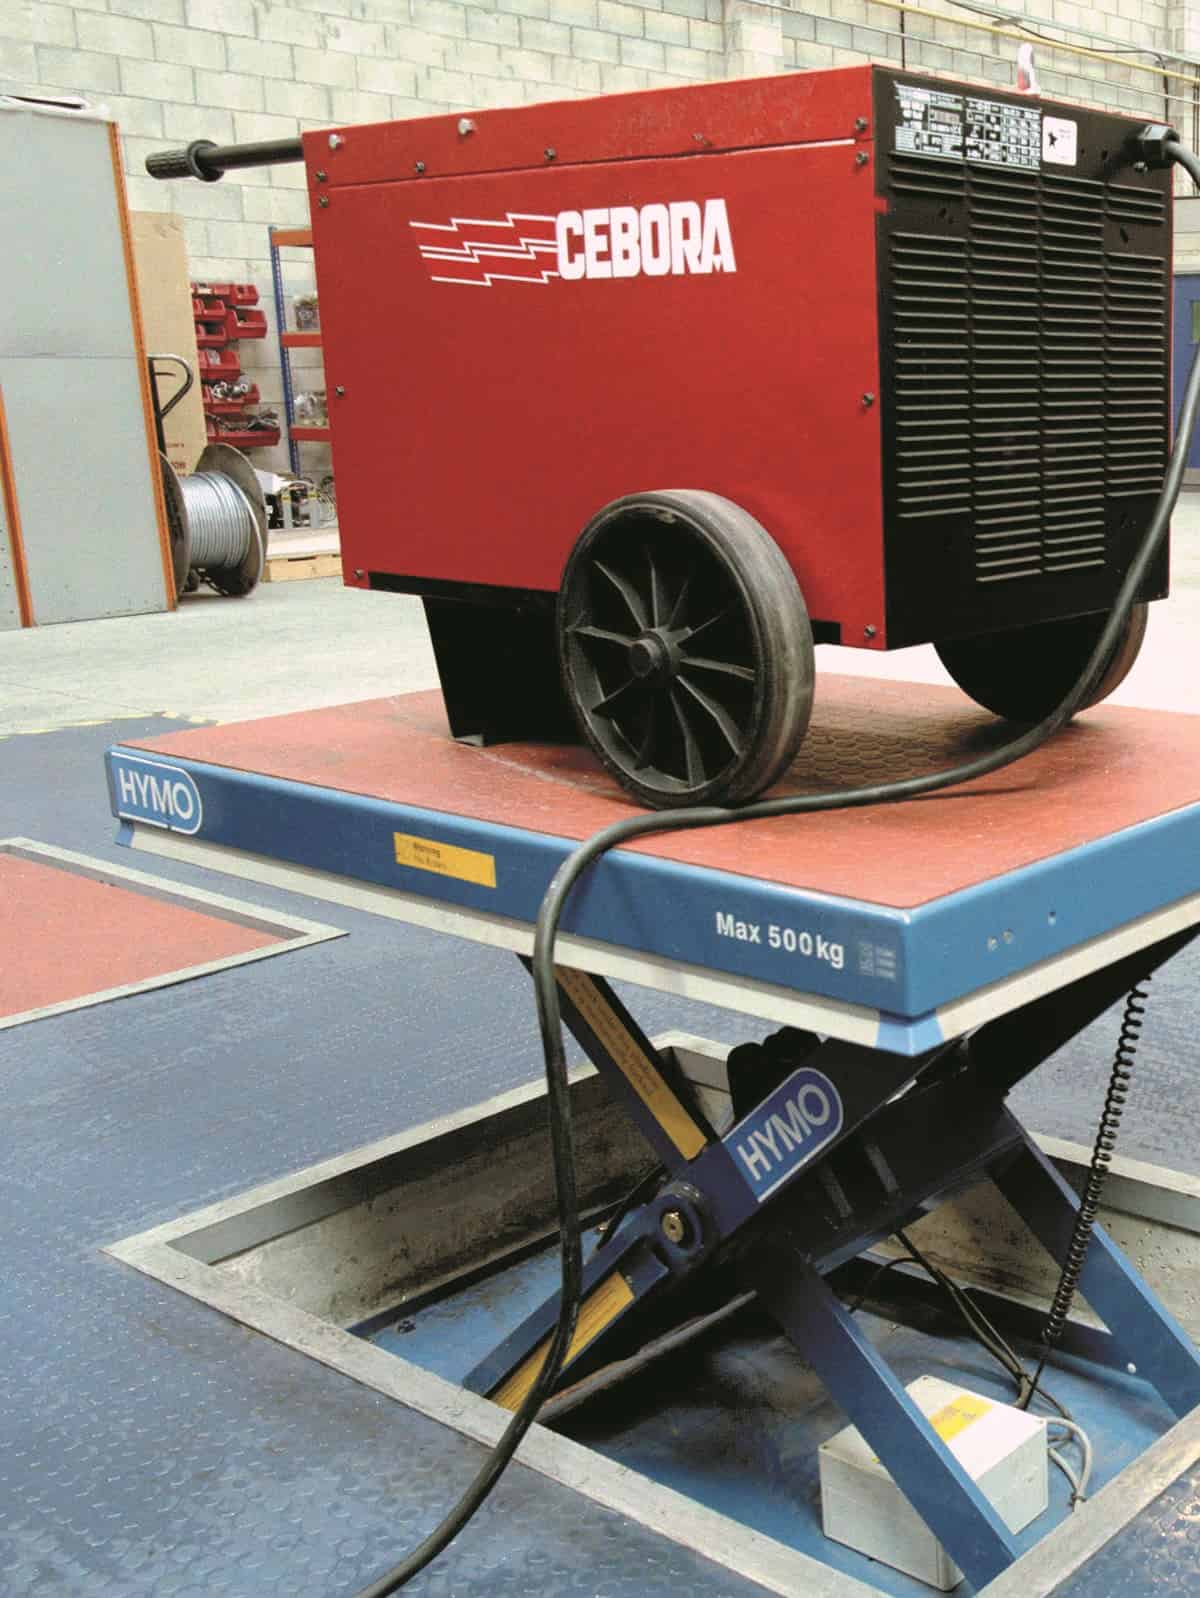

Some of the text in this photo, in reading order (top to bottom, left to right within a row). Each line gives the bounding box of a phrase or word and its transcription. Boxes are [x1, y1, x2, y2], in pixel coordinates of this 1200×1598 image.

[555, 198, 737, 281] CEBORA
[119, 767, 194, 821] HYMO
[715, 911, 762, 945] Max
[737, 1083, 831, 1182] HYMO
